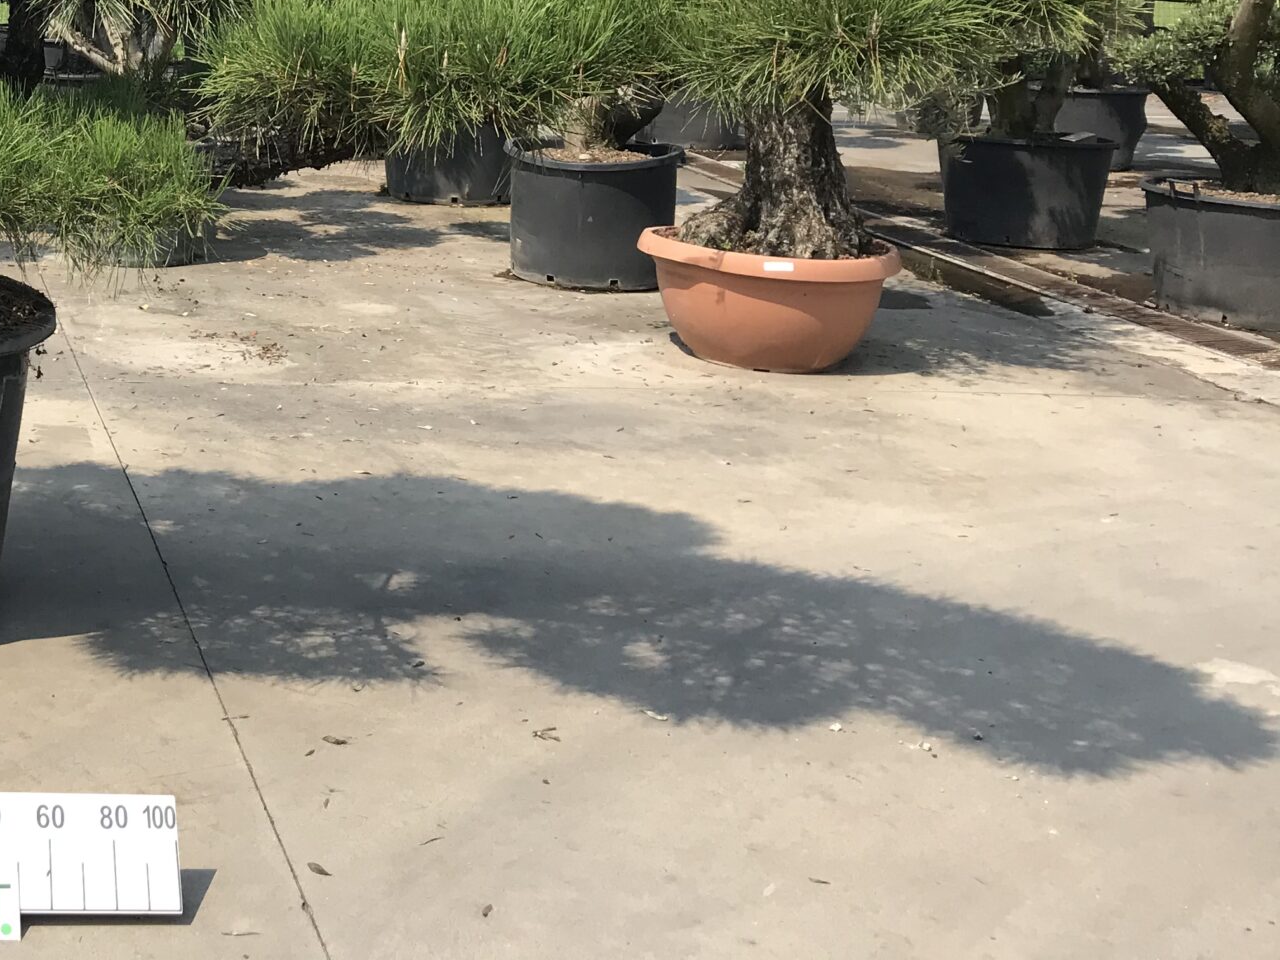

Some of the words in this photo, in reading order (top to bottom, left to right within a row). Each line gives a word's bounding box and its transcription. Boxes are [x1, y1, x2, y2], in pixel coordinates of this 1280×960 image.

[36, 804, 65, 829] 60
[100, 805, 128, 830] 80
[142, 804, 177, 829] 100
